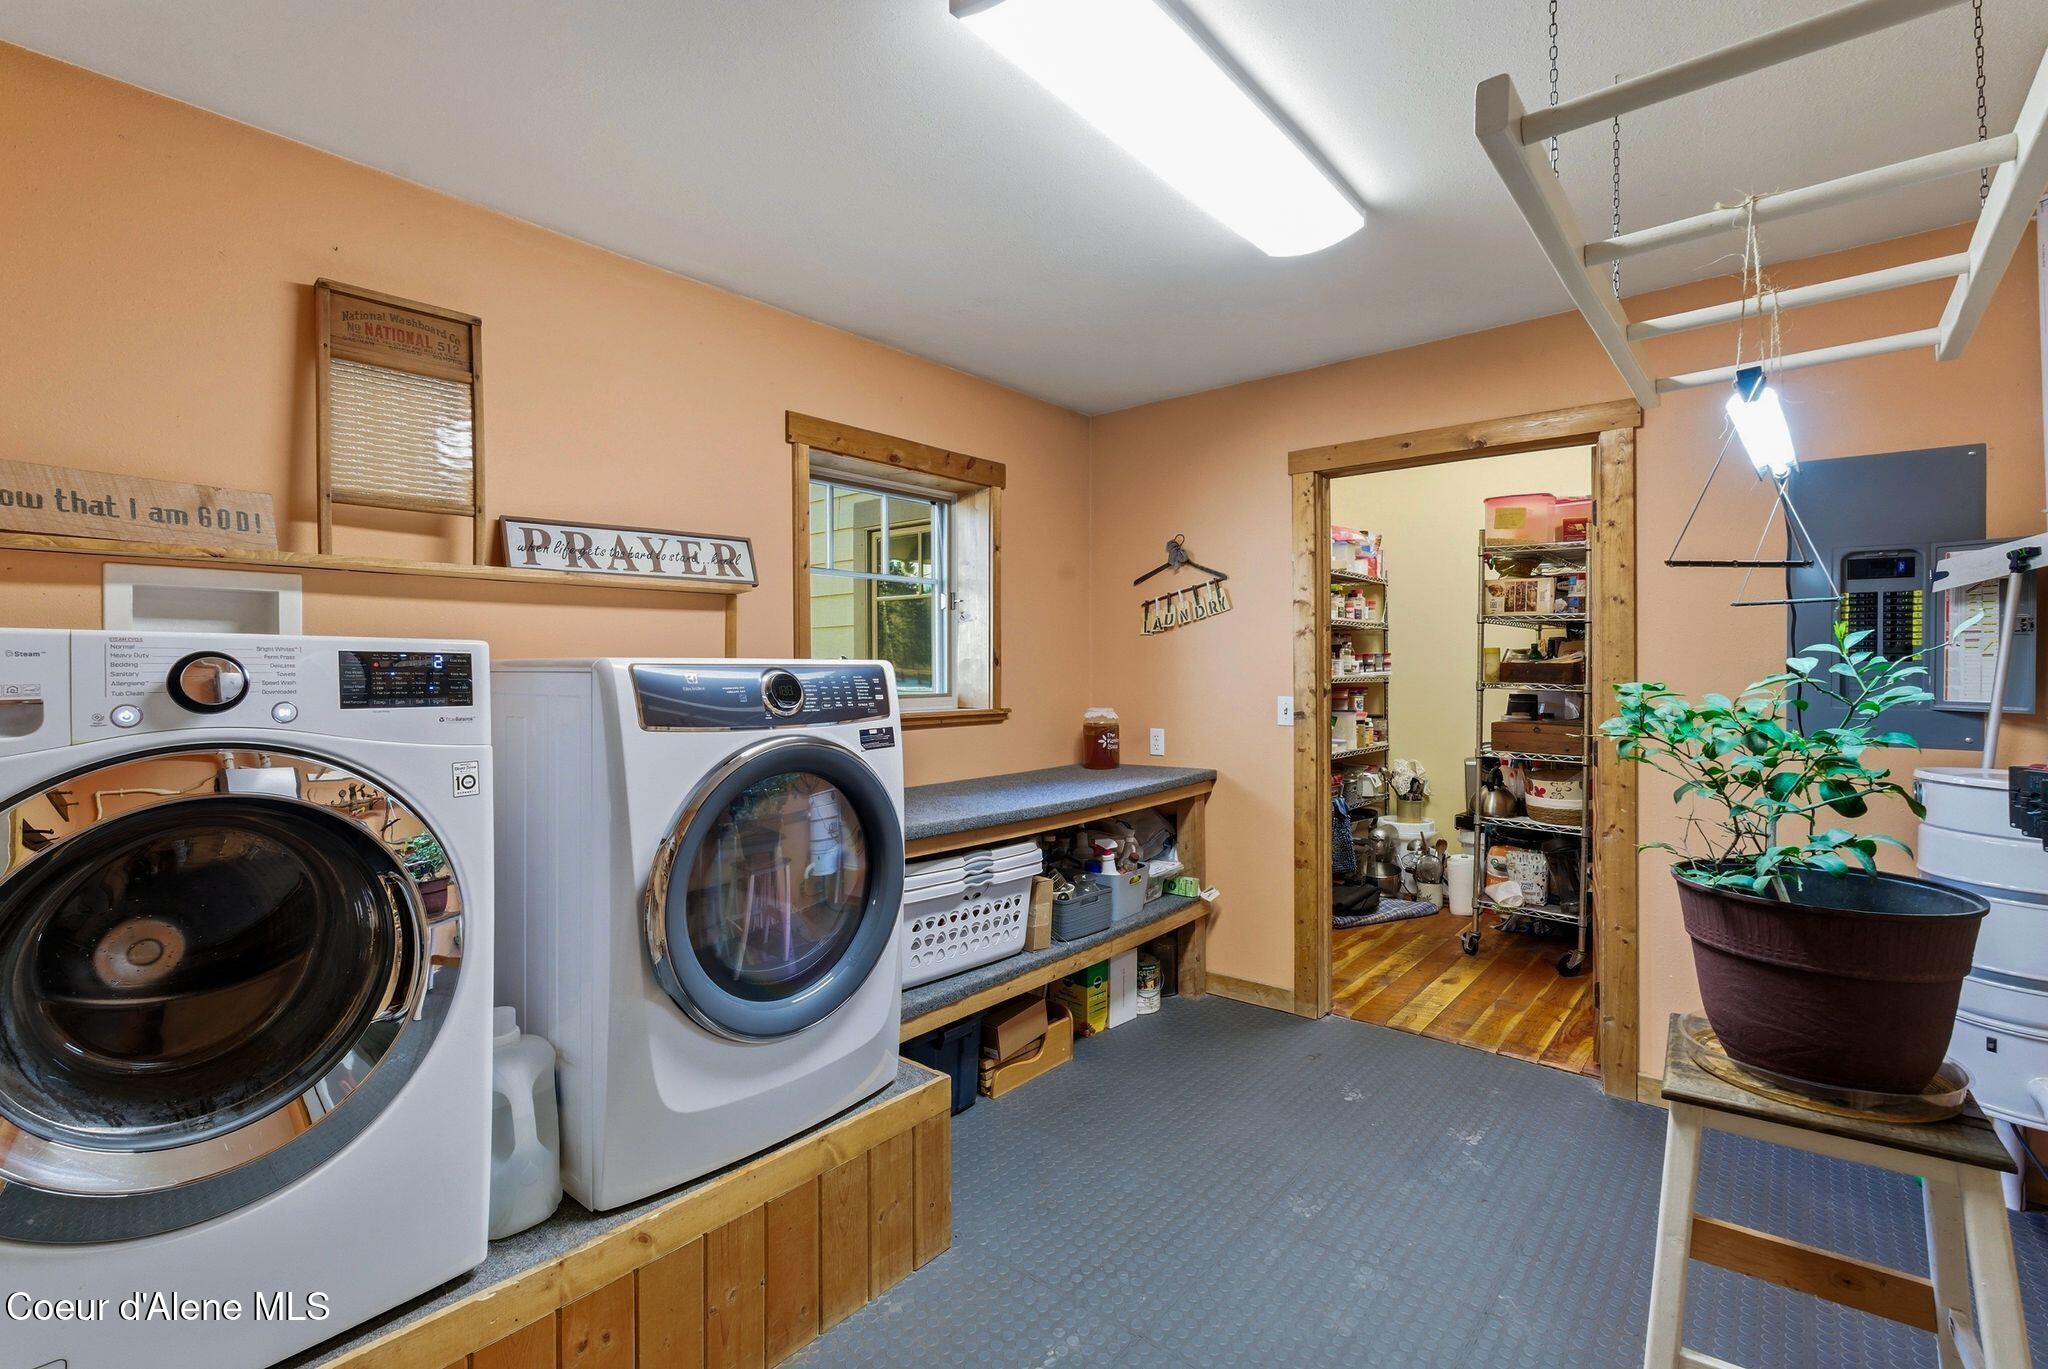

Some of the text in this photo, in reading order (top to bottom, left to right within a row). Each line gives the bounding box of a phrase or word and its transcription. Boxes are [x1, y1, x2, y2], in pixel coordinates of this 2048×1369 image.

[342, 310, 386, 321] National
[389, 313, 447, 339] Washboard
[364, 321, 433, 349] NATIONAL
[437, 342, 460, 355] 512
[54, 488, 120, 518] that
[129, 497, 137, 519] I
[149, 506, 189, 526] am
[198, 506, 262, 534] GOD!
[518, 526, 745, 578] PRAYER
[1144, 597, 1227, 633] LAUNDRY
[456, 774, 476, 791] 10
